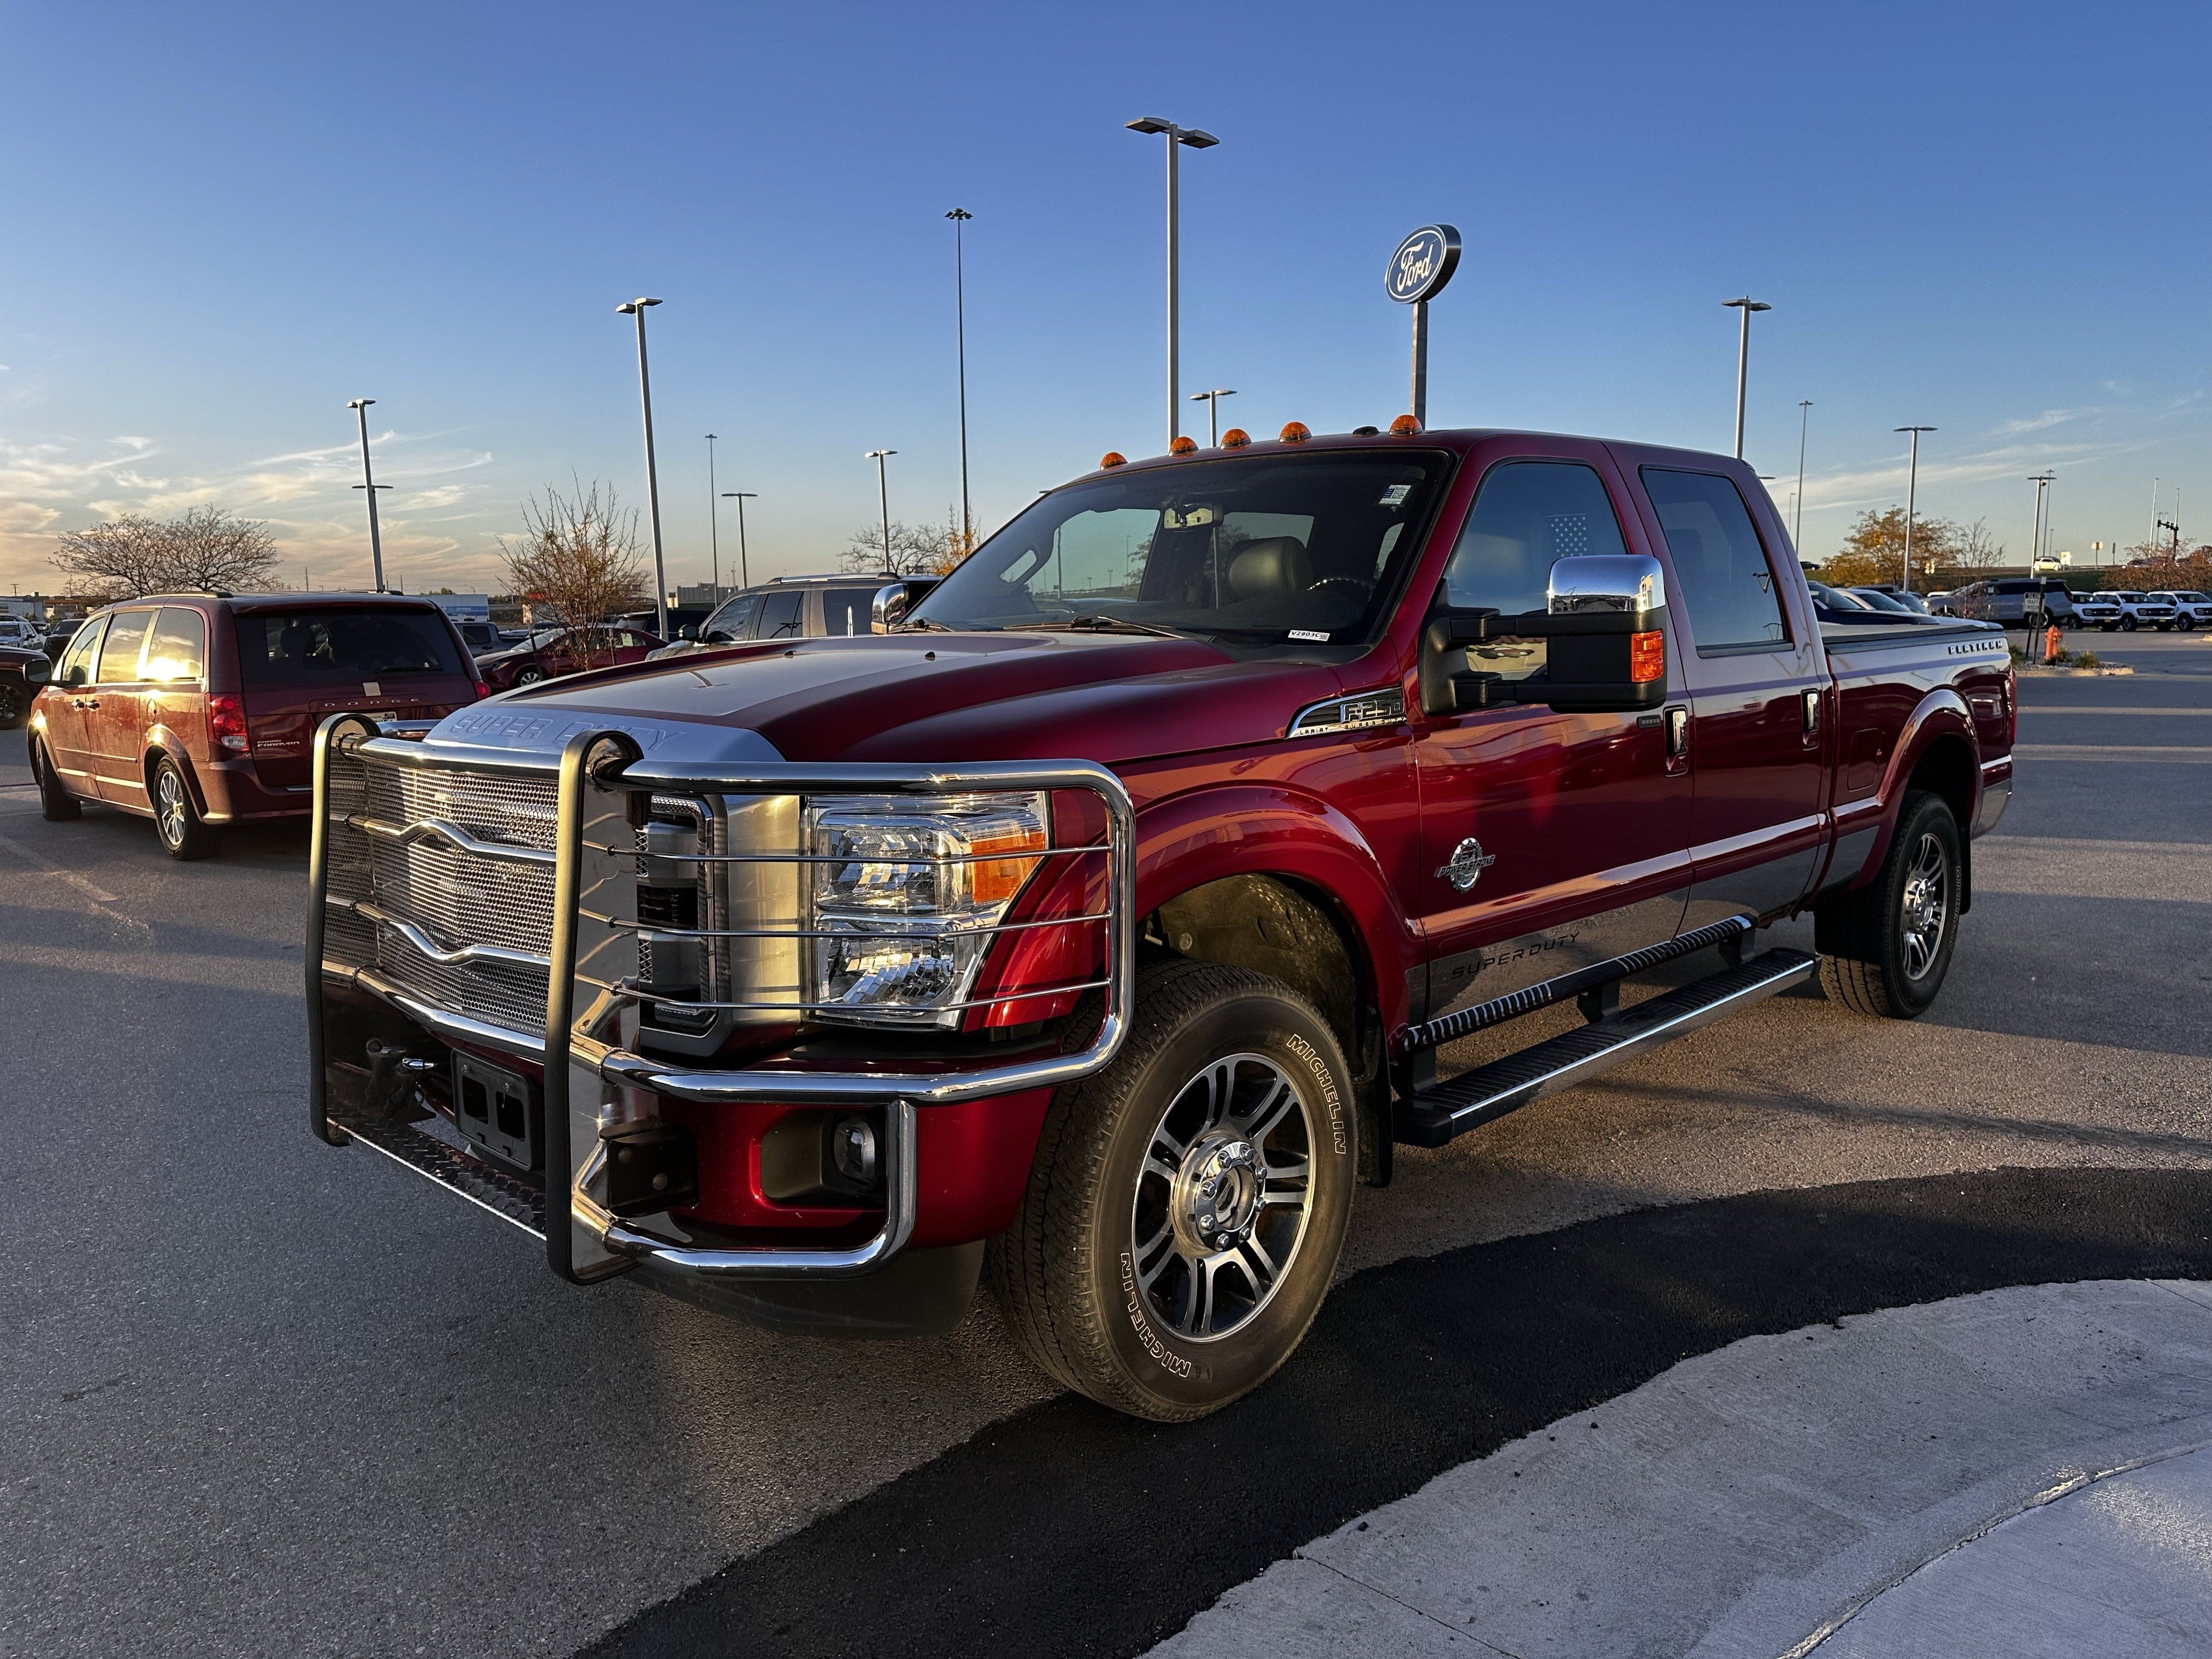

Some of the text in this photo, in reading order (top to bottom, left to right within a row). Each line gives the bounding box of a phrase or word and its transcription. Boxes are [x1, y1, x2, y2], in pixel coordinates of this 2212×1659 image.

[1397, 240, 1434, 292] Ford
[1948, 641, 2002, 655] PLATINUM
[324, 698, 419, 707] DODGE
[1340, 698, 1404, 723] F-250
[450, 714, 554, 740] SUPER
[1299, 727, 1329, 735] LARIAT
[1345, 721, 1376, 729] SUPER
[1451, 932, 1579, 980] SUPER DUTY
[1286, 1033, 1346, 1154] MICHELIN
[1120, 1252, 1192, 1378] MICHELIN
